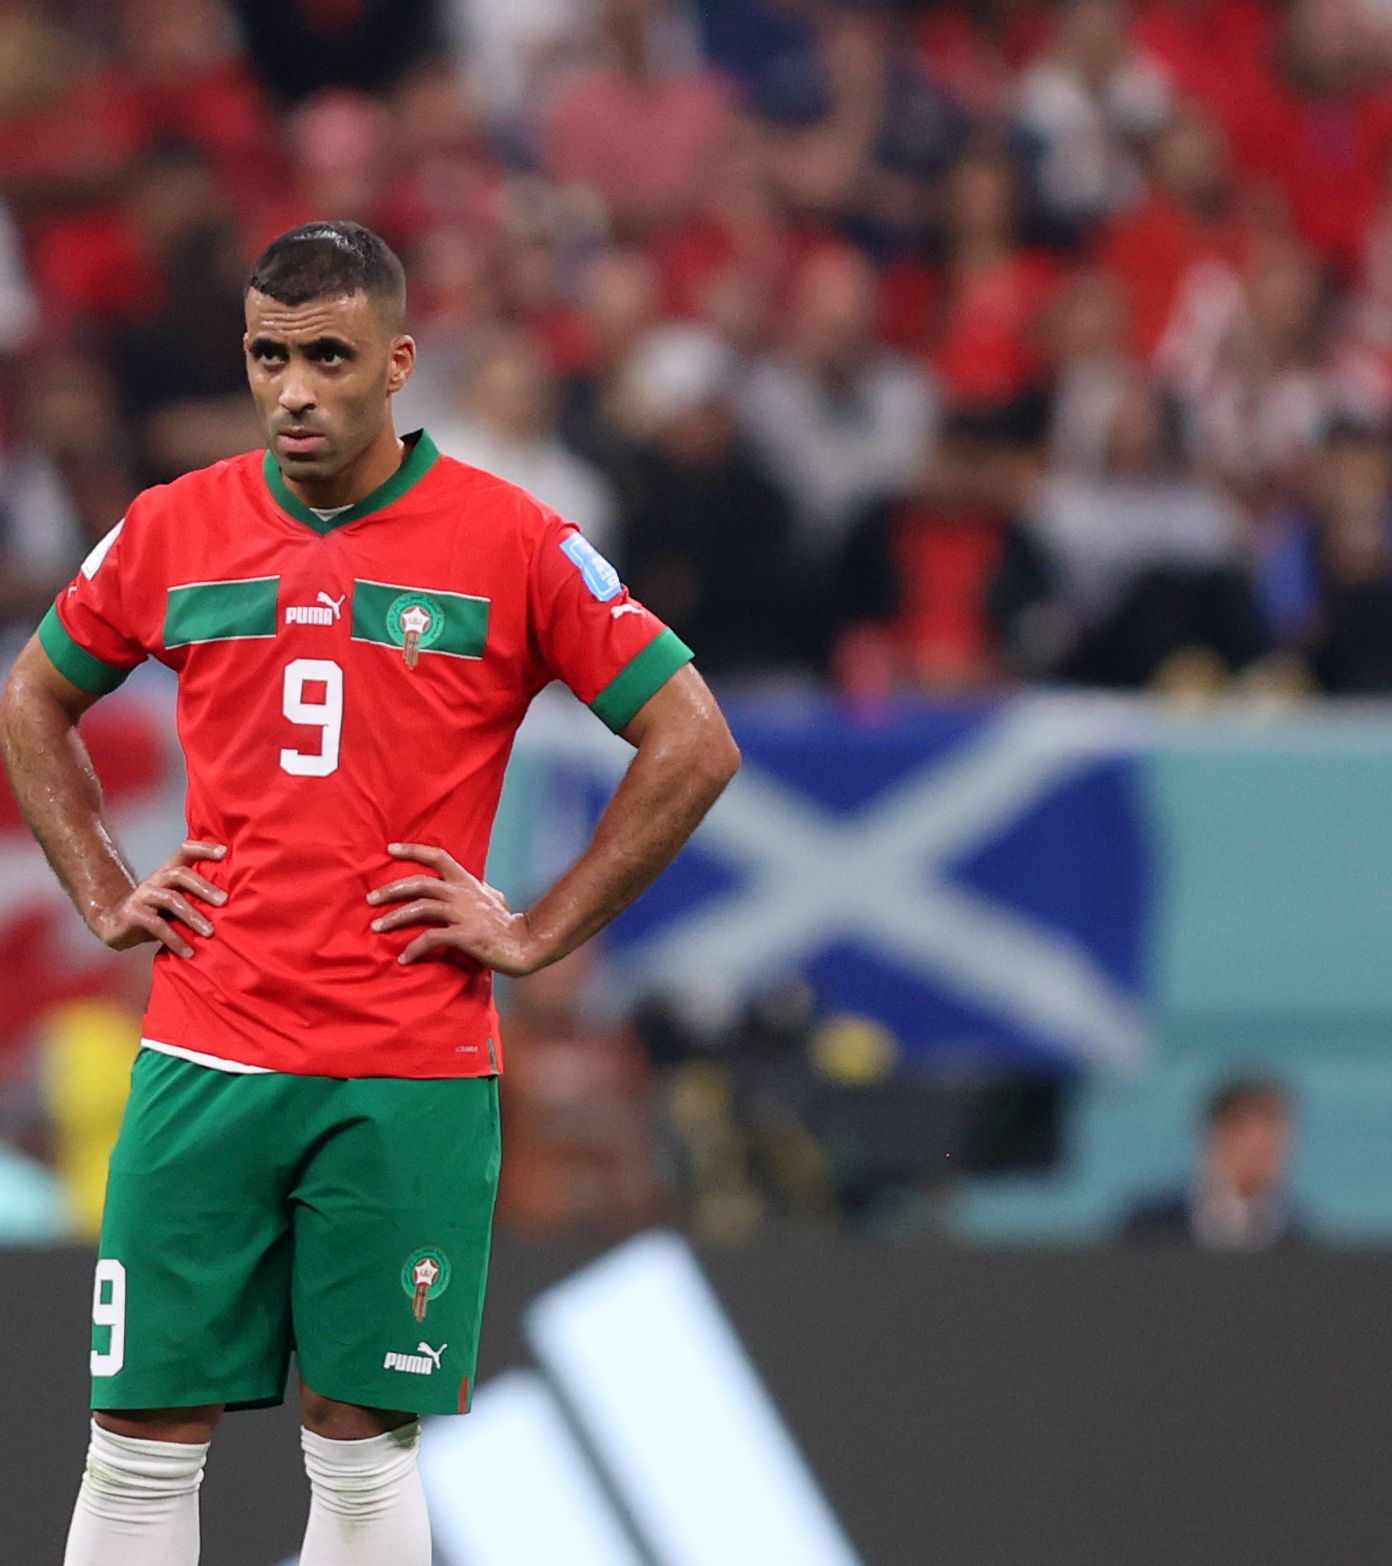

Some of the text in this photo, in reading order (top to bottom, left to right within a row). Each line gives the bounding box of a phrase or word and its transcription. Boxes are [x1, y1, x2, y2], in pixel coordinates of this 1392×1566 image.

[285, 606, 333, 626] PUMA
[279, 658, 343, 777] 9
[89, 1258, 126, 1377] 9
[383, 1352, 433, 1375] PUMA
